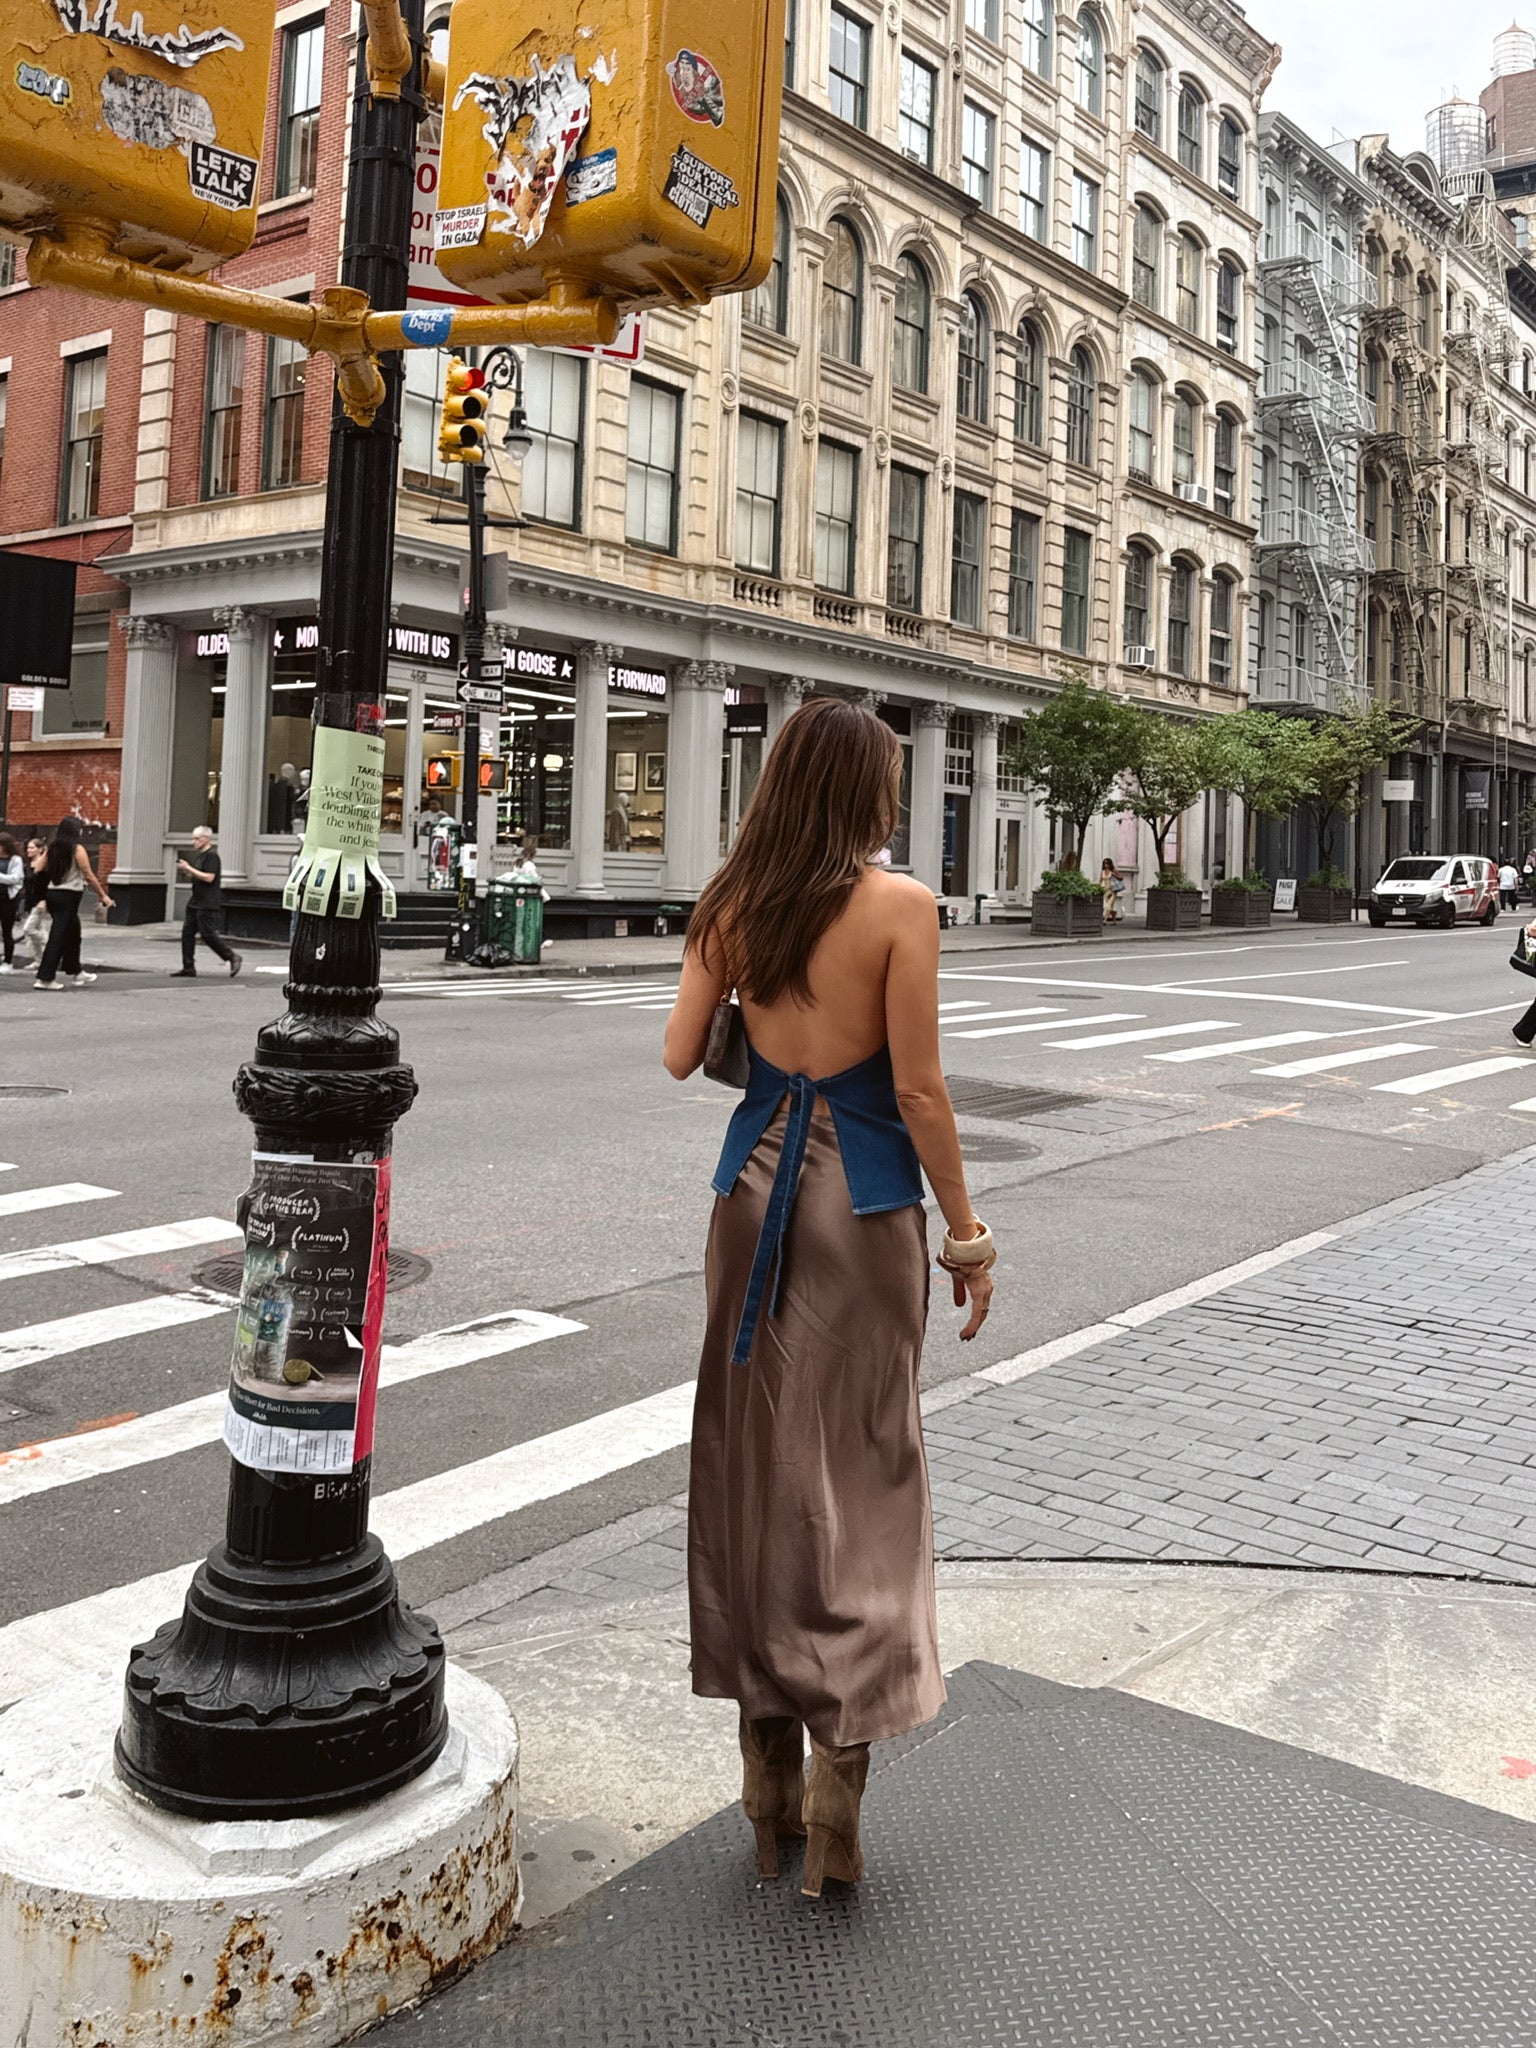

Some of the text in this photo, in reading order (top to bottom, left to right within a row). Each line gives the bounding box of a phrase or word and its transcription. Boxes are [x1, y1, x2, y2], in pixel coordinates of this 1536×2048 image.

[197, 147, 252, 182] LET'S
[683, 153, 732, 189] SUPPORT
[196, 165, 247, 199] TALK
[673, 157, 702, 183] YOUR
[703, 177, 739, 206] LOCAL
[194, 188, 236, 208] NEW YORK
[680, 174, 727, 208] DEALER!
[435, 211, 456, 221] STOP
[442, 218, 480, 232] MURDER
[441, 231, 478, 246] IN GAZA
[408, 317, 436, 333] Dept
[395, 628, 451, 659] WITH US
[484, 667, 499, 675] WAY
[517, 650, 557, 676] GOOSE
[410, 670, 427, 682] 468
[617, 668, 666, 695] FORWARD
[462, 687, 498, 699] ONE WAY
[357, 765, 377, 777] TAKE
[350, 775, 360, 787] If
[324, 785, 352, 801] West
[322, 800, 369, 820] doubling
[326, 815, 374, 834] the white
[339, 834, 361, 845] and
[299, 1232, 343, 1243] PLATINUM
[266, 1402, 281, 1413] Bad
[281, 1405, 321, 1415] Decisions.
